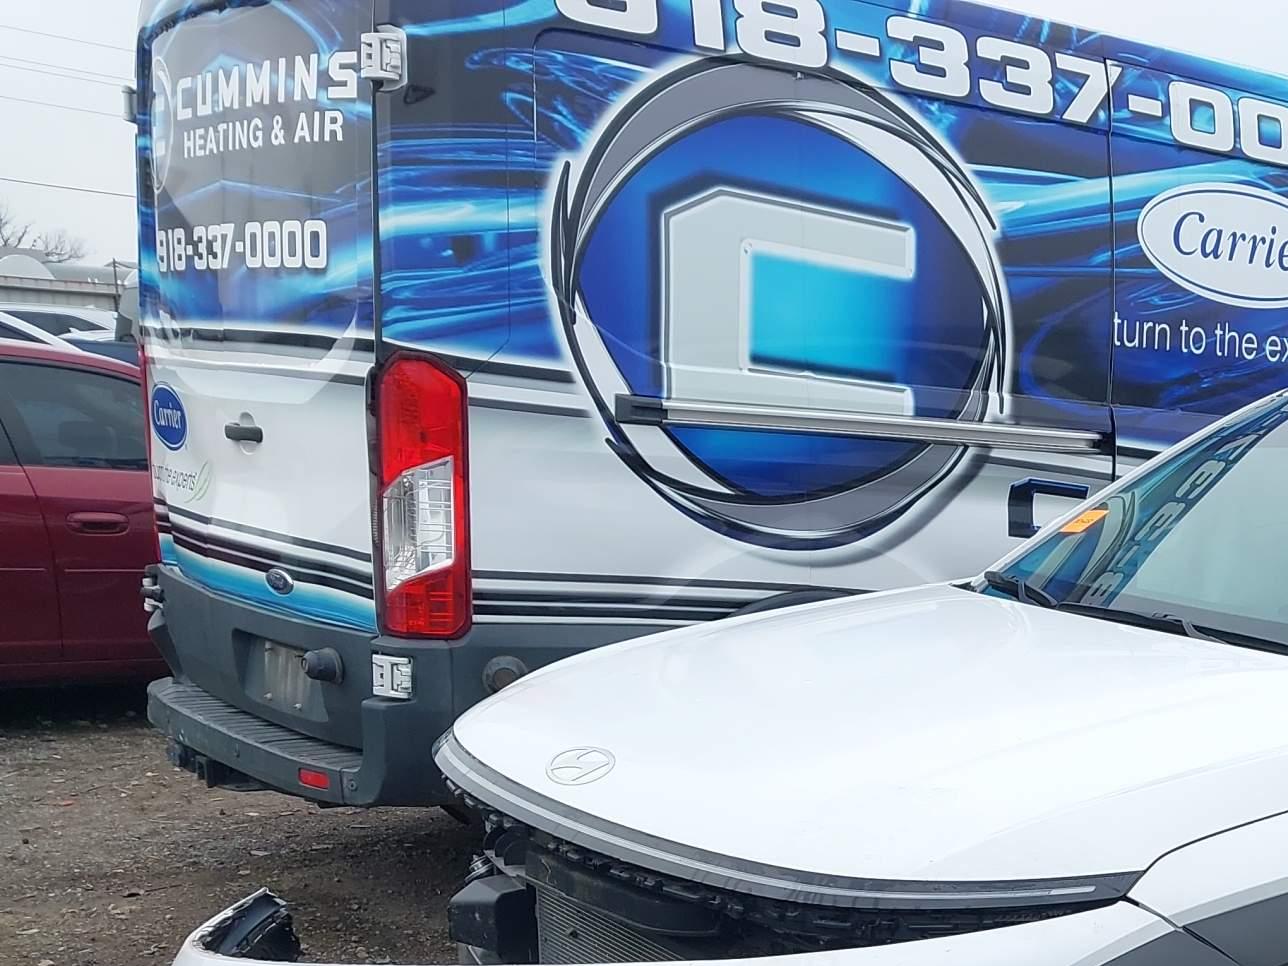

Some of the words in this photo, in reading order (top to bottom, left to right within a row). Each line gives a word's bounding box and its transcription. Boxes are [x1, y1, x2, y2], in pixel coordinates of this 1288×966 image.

[177, 51, 358, 120] CUMMINS
[184, 117, 263, 159] HEATING
[271, 115, 285, 146] &
[294, 110, 344, 143] AIR
[157, 220, 327, 272] 918-337-0000
[1113, 311, 1171, 350] turn
[1180, 319, 1206, 354] to
[1215, 322, 1258, 359] the
[153, 400, 182, 430] Carrier
